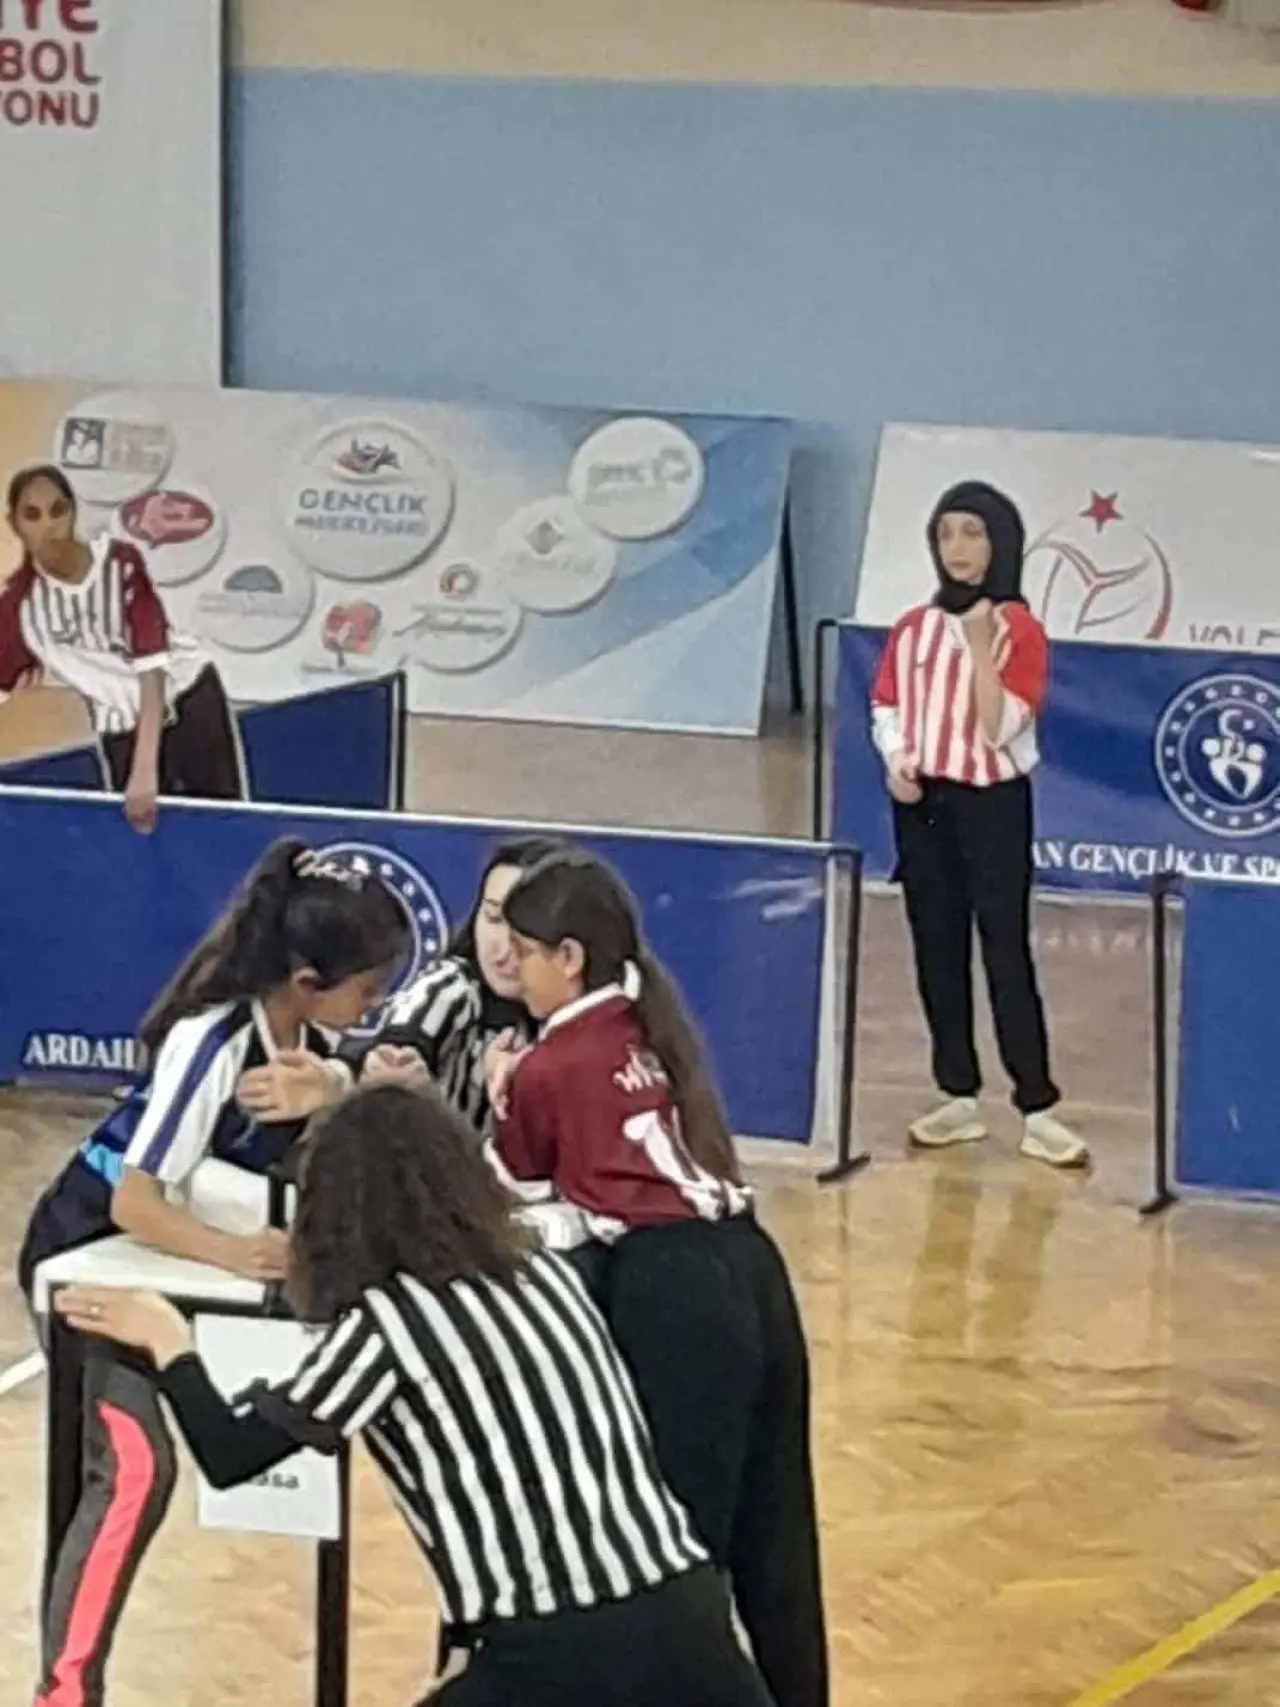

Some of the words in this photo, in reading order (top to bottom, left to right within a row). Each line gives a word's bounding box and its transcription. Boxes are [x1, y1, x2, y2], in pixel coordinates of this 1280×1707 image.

[0, 0, 98, 33] YE
[0, 89, 99, 128] ONU
[1244, 855, 1280, 881] SP
[23, 1033, 136, 1071] ARDAH
